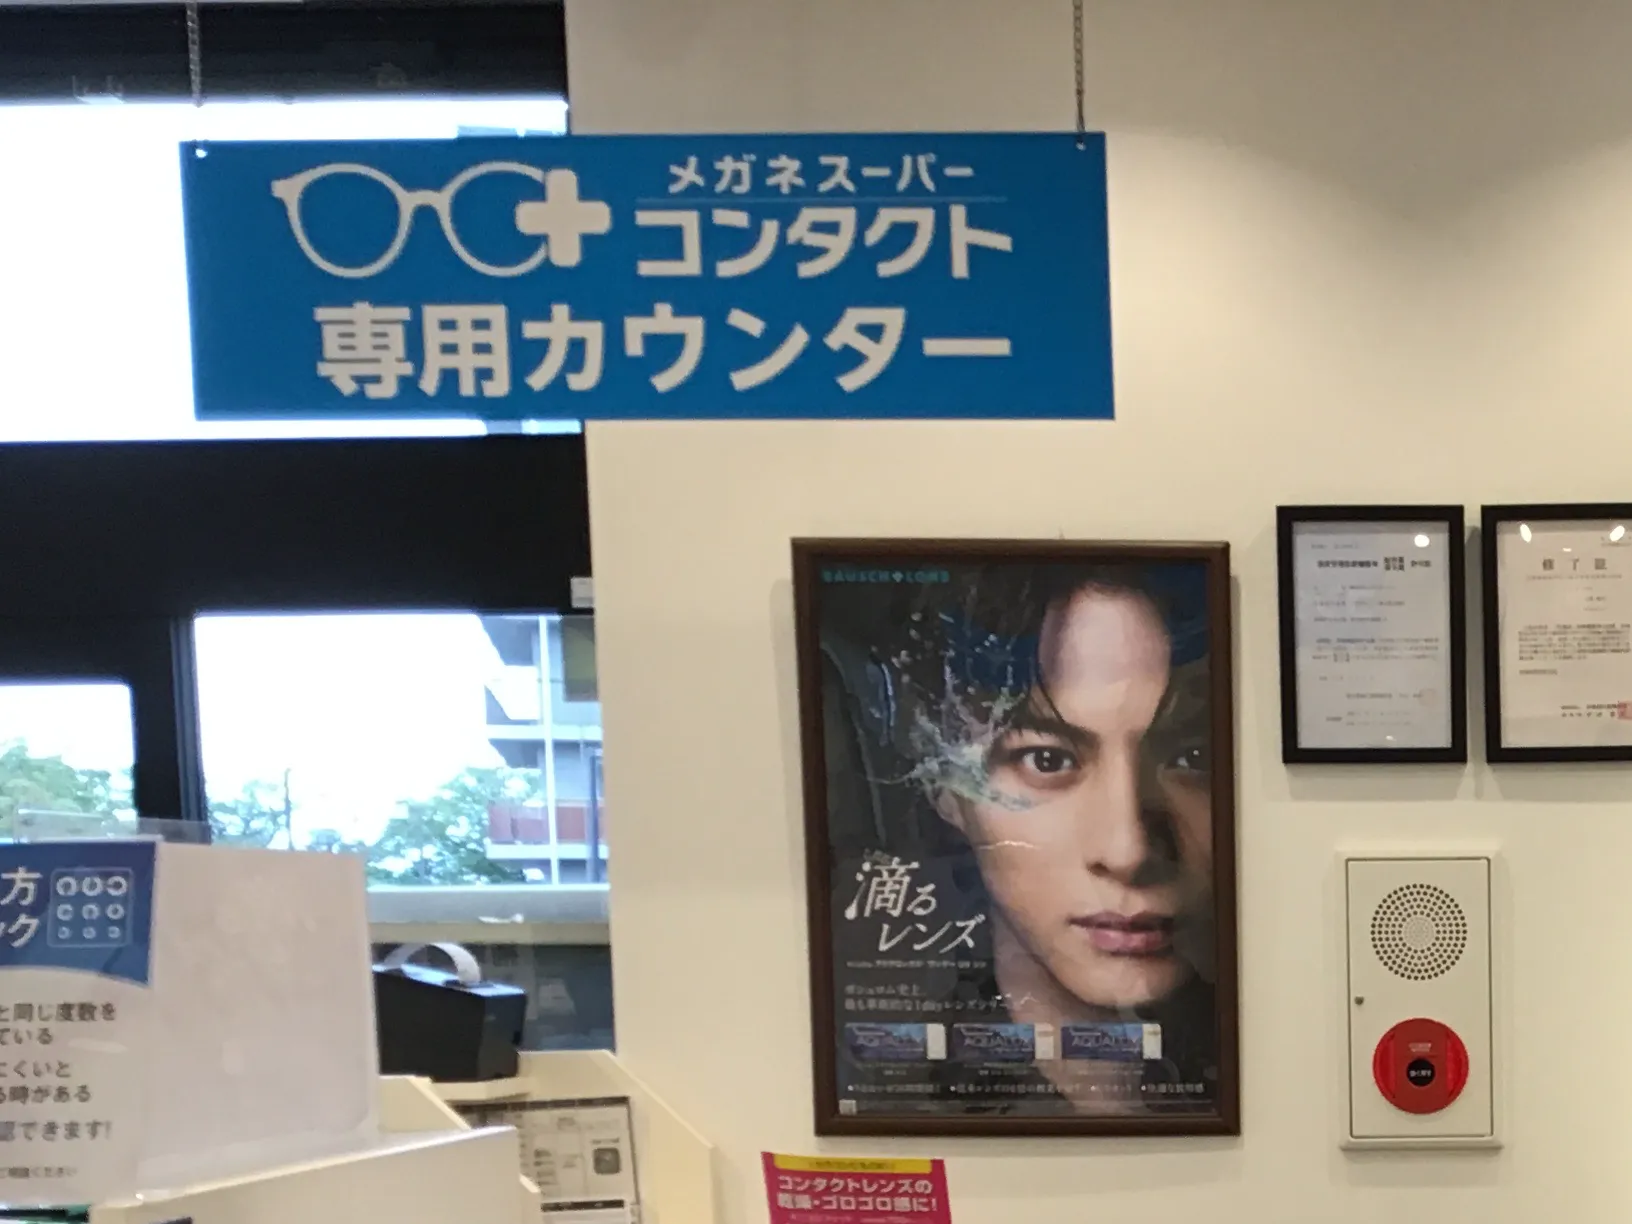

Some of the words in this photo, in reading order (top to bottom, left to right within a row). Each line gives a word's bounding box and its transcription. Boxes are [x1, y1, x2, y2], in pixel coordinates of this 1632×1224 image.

[668, 154, 975, 195] メガネスーパー
[634, 204, 1013, 279] コンタクト
[314, 302, 1013, 399] 専用カウンター
[1, 866, 42, 906] 方
[844, 855, 938, 921] 滴る
[0, 913, 41, 949] ク
[877, 913, 987, 953] レンズ
